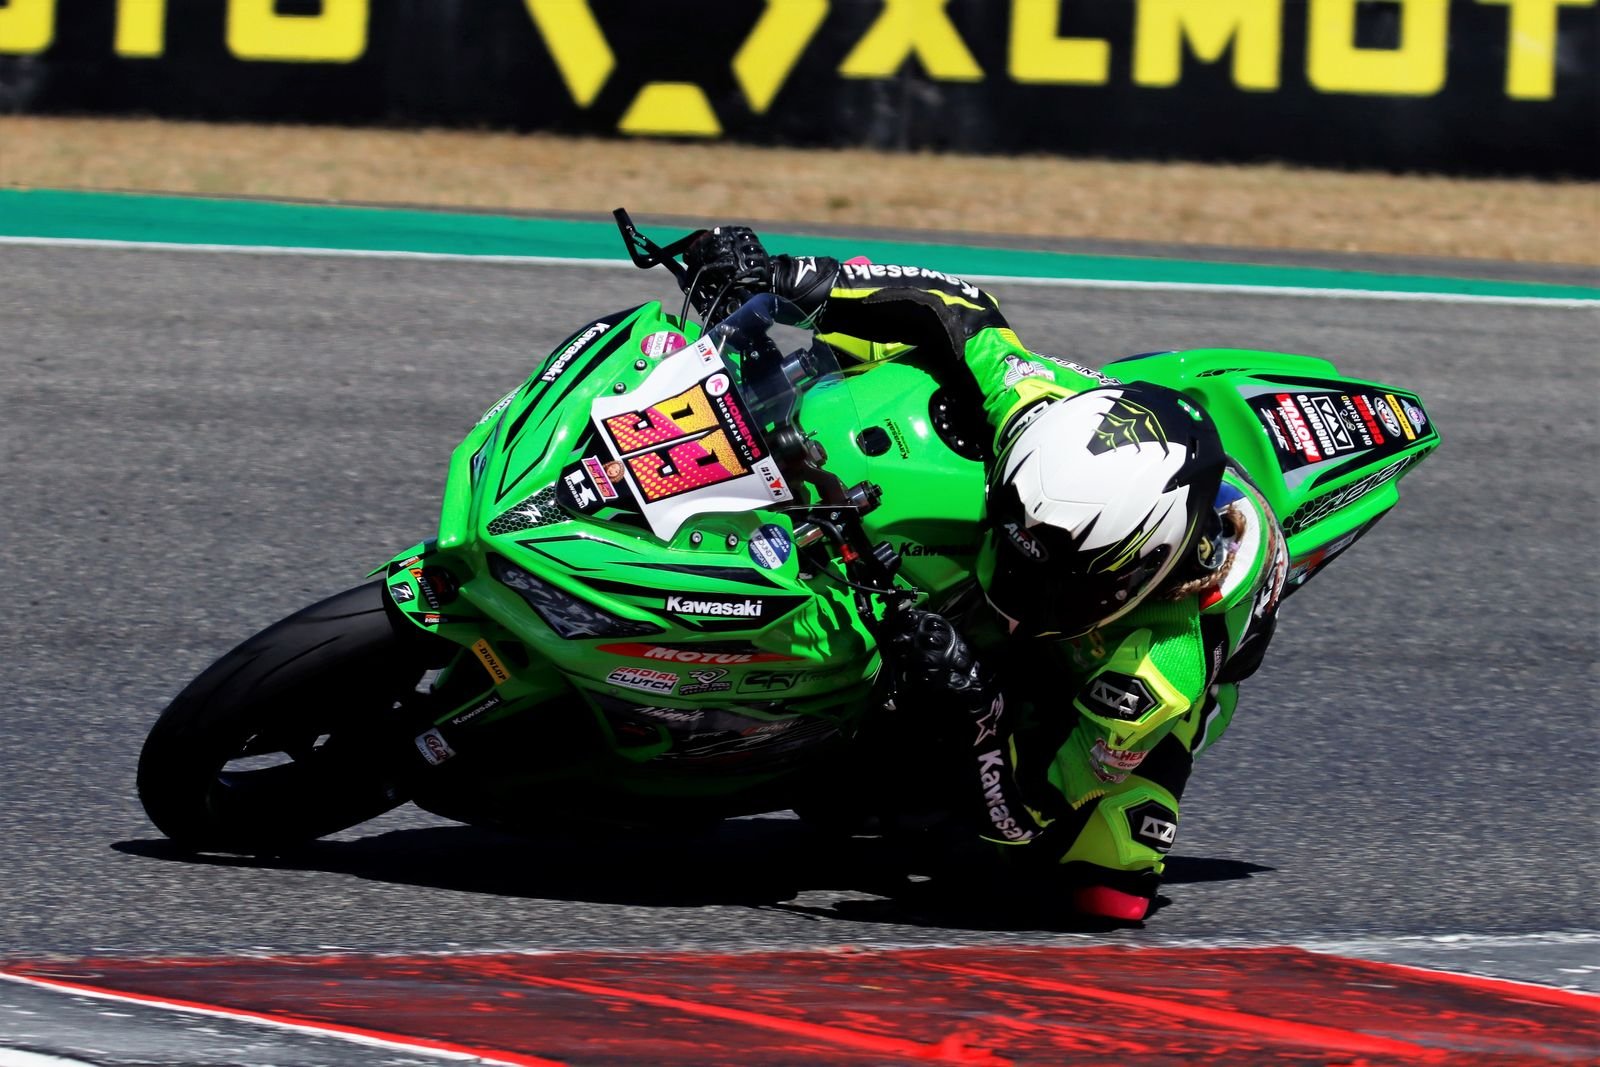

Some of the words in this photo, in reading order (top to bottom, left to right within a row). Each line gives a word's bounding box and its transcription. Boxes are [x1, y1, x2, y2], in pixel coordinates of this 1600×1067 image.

[843, 263, 979, 299] Kawasaki
[541, 322, 610, 383] Kawasaki
[722, 393, 762, 458] WOMEN'S
[1282, 396, 1319, 458] MOTUL
[1297, 394, 1336, 455] GHIGOMOTO
[1340, 395, 1362, 424] ISLAND
[601, 384, 753, 505] 99
[715, 396, 743, 446] EUROPEAN
[739, 444, 754, 462] CUP
[884, 418, 909, 460] Kawasaki
[1277, 406, 1303, 450] Kawasaki
[1354, 420, 1368, 435] AN
[1361, 433, 1373, 446] ON
[564, 475, 585, 509] Kawasaki
[1005, 522, 1042, 559] Airoh
[665, 595, 763, 617] Kawasaki
[478, 646, 508, 681] DUNLOP
[649, 646, 753, 664] MOTUL
[608, 673, 676, 692] CLUTCH
[613, 666, 678, 682] RADIAL
[452, 696, 500, 726] Kawasaki
